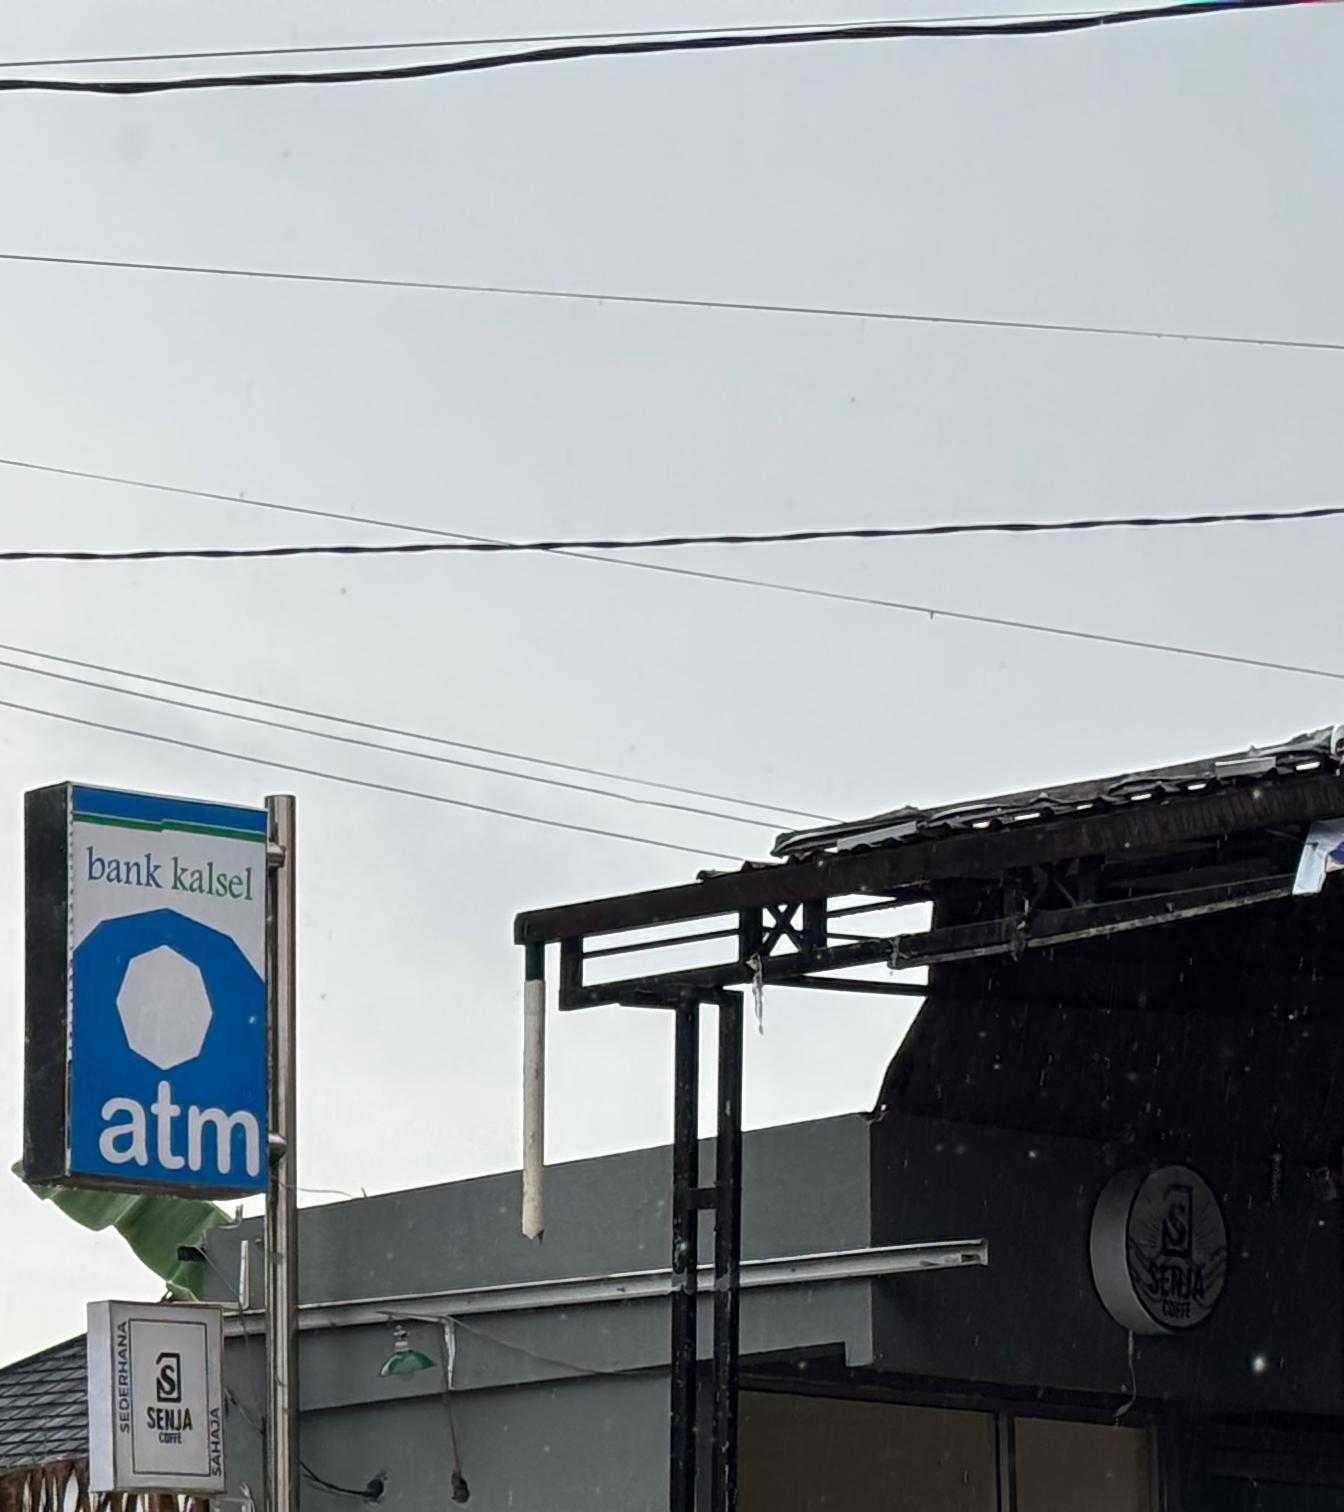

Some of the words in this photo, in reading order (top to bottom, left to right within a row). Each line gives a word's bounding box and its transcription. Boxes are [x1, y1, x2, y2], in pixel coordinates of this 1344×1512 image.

[86, 846, 163, 888] bank
[171, 857, 253, 900] kalsel
[98, 1080, 260, 1177] atm
[1148, 1262, 1206, 1299] SENJA
[116, 1321, 130, 1434] SEDERHANA
[147, 1406, 193, 1431] SENJA
[210, 1407, 222, 1477] SAHAJA
